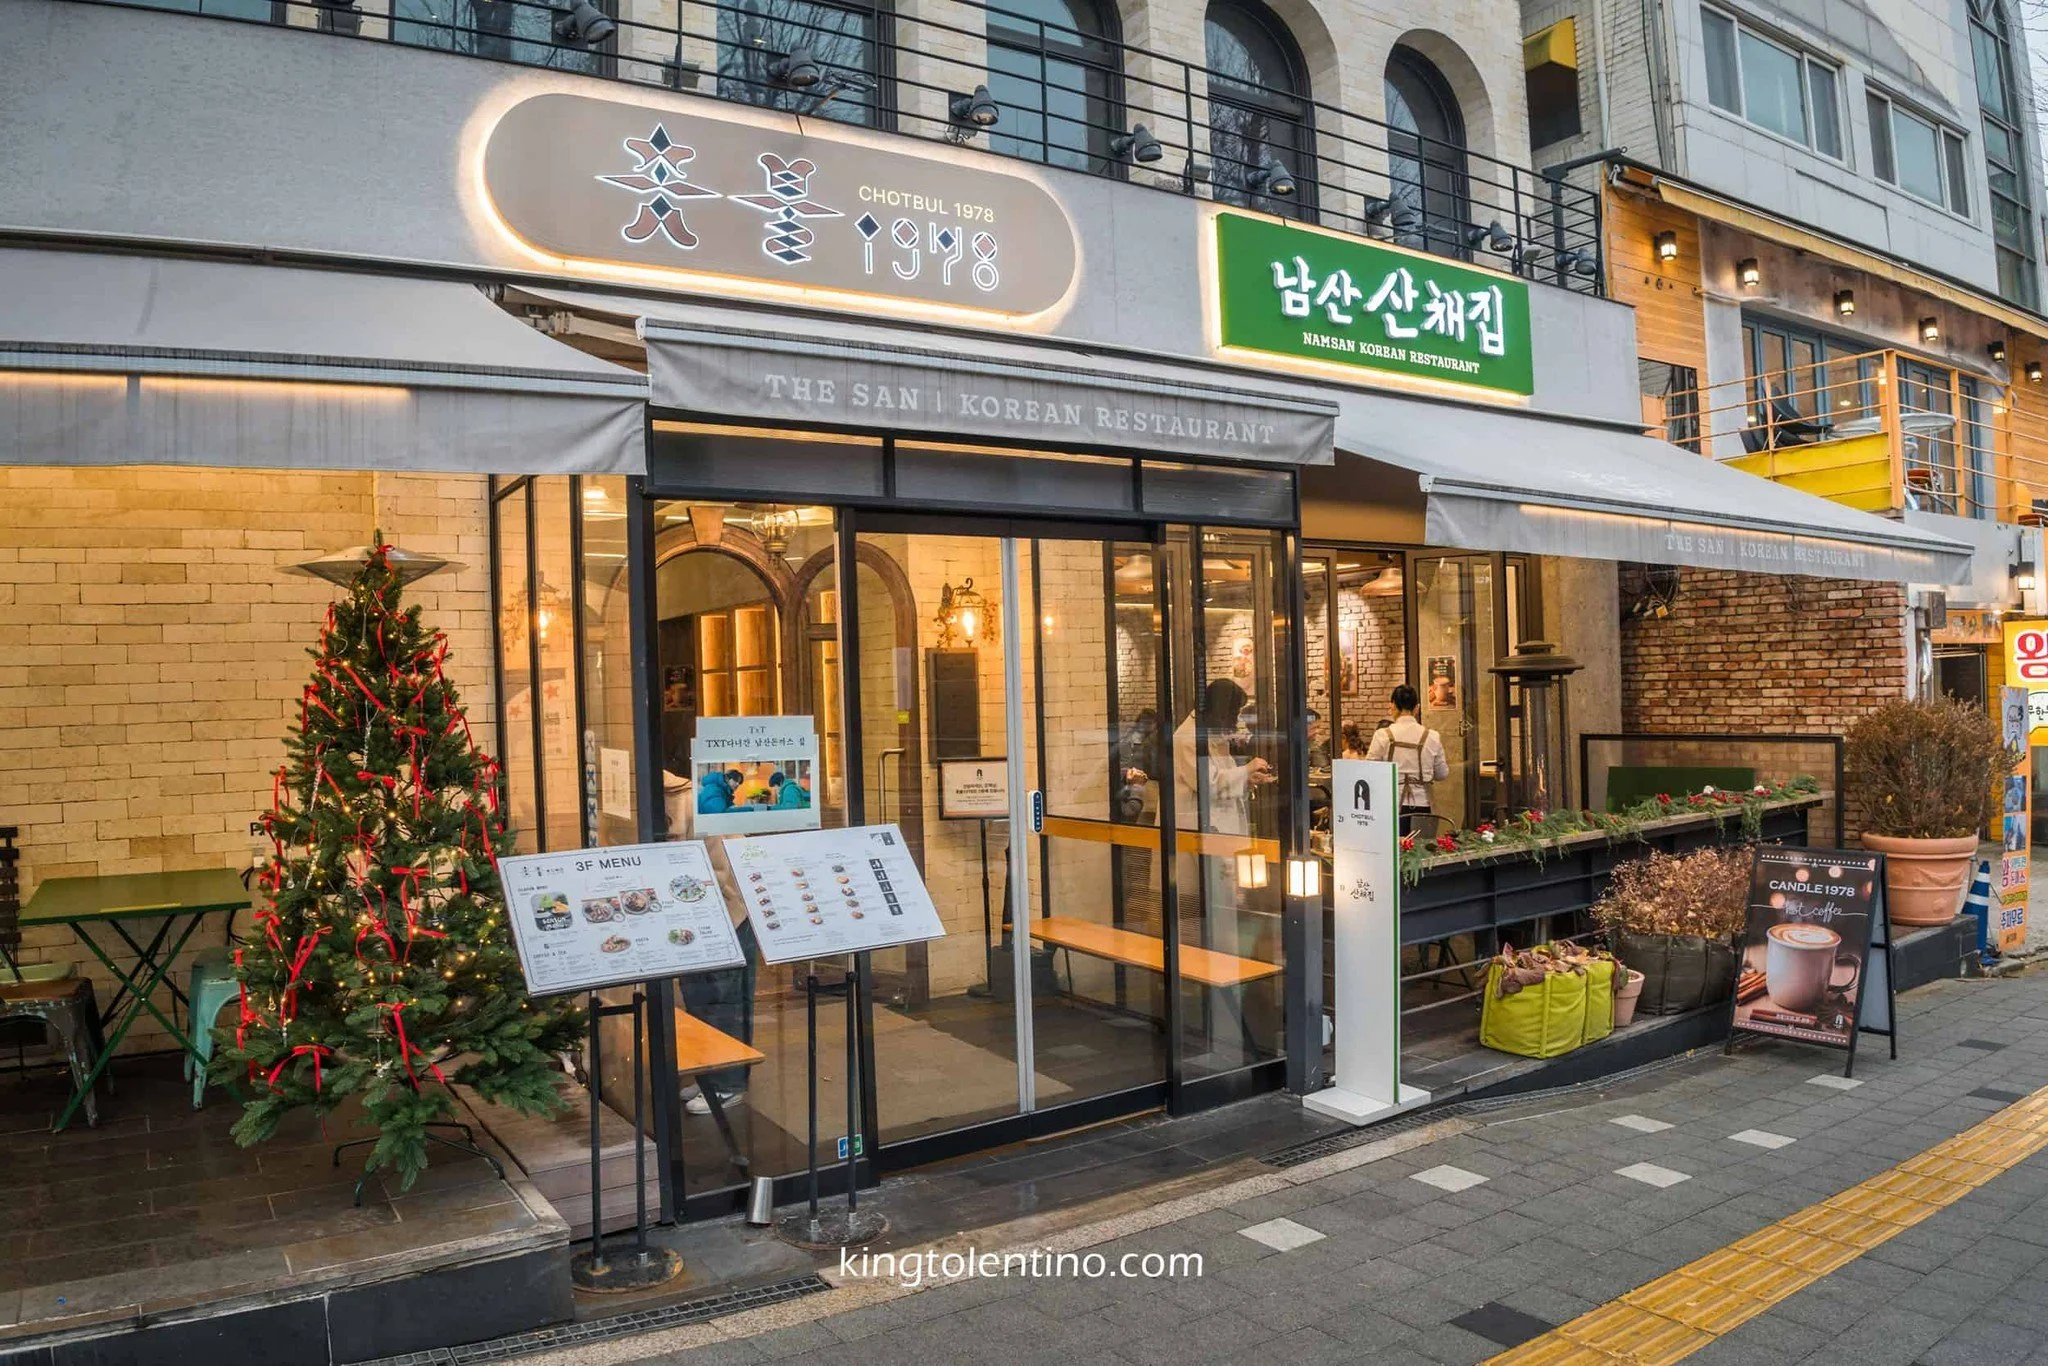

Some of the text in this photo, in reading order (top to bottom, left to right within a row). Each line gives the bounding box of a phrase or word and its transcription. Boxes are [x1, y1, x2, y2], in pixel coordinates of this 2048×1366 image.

[858, 184, 995, 223] CHOTBUL 1978
[854, 210, 1000, 292] 1978
[1302, 331, 1481, 374] NAMSAN KOREAN RESTAURANT
[765, 373, 836, 404] THE
[852, 383, 919, 410] SAN
[959, 393, 1082, 426] KOREAN
[1095, 406, 1274, 445] RESTAURANT
[1664, 533, 1693, 553] THE
[1697, 537, 1725, 556] SAN
[1740, 541, 1788, 561] KOREAN
[1794, 543, 1866, 568] RESTAURANT
[575, 861, 594, 872] 3F
[600, 855, 642, 870] MENU
[1811, 901, 1844, 923] coffee
